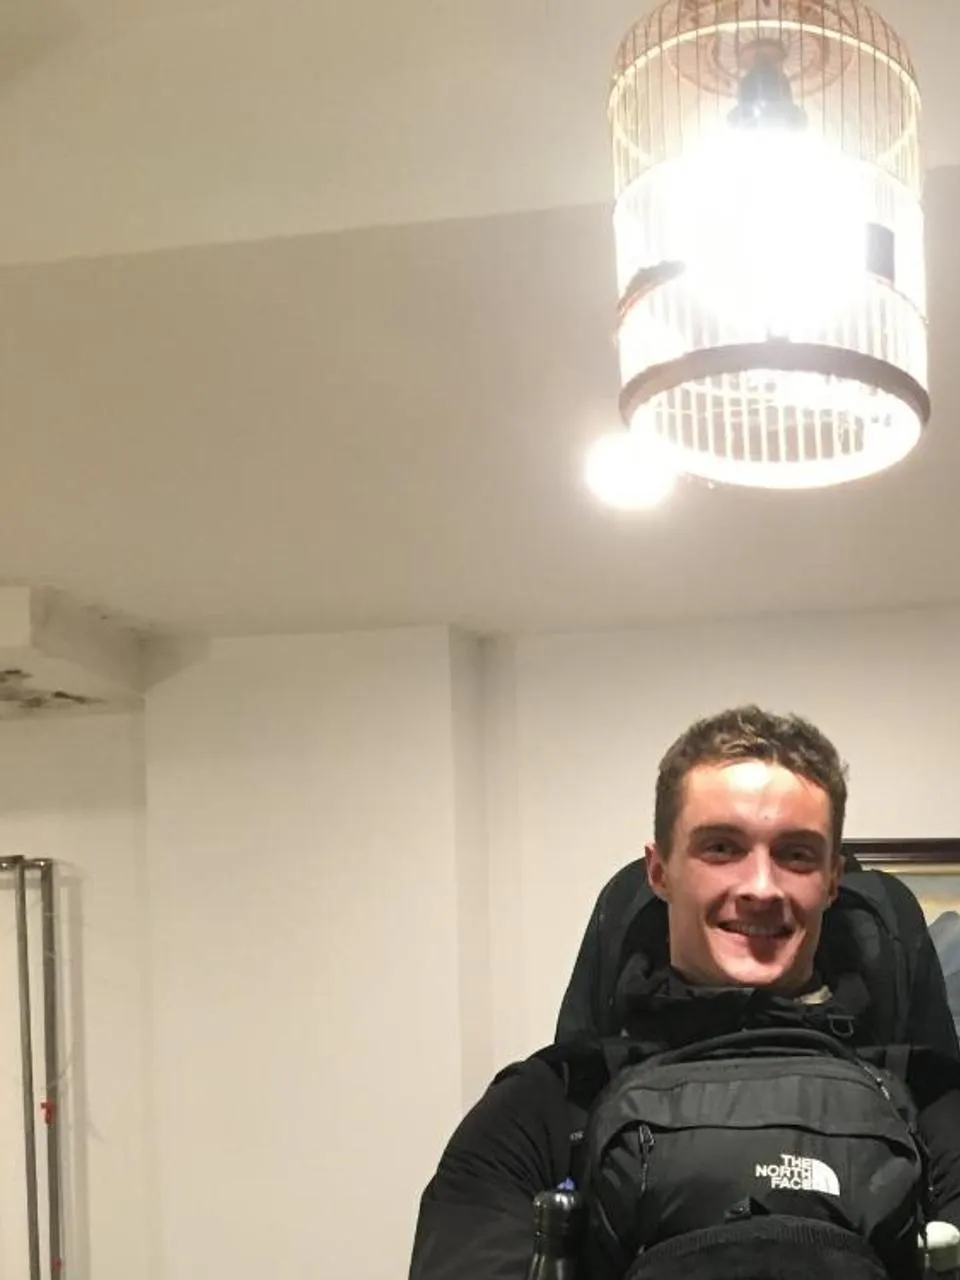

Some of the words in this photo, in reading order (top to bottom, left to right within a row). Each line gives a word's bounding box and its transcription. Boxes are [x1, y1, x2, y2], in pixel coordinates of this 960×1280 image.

[780, 1154, 812, 1168] THE
[755, 1164, 812, 1178] NORTH
[770, 1176, 812, 1190] FACE
